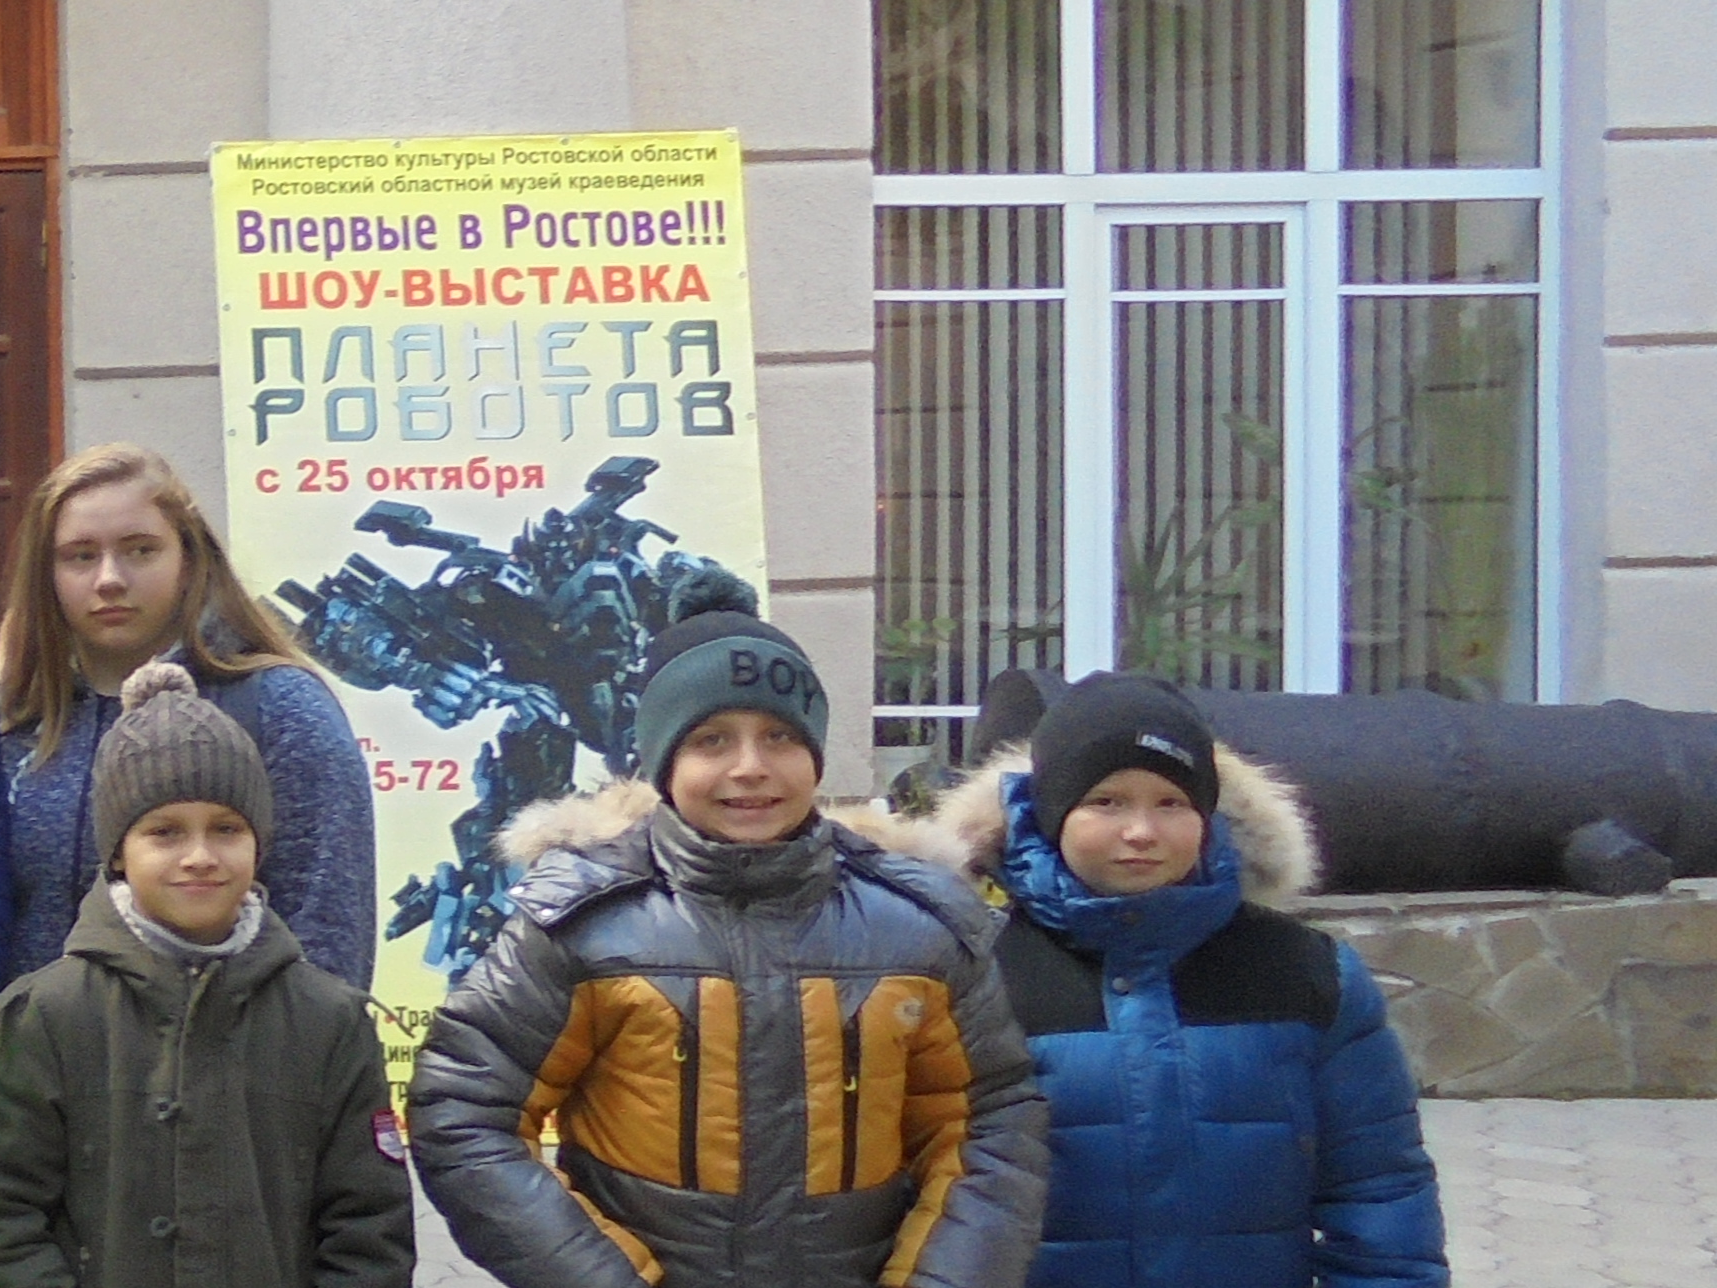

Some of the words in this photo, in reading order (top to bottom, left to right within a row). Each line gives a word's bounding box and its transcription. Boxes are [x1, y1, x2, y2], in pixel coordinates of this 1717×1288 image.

[237, 153, 387, 172] Министерство
[395, 152, 495, 171] культуры
[502, 145, 623, 165] Ростовской
[631, 144, 718, 163] области
[252, 176, 374, 196] Ростовский
[381, 174, 493, 194] областной
[500, 173, 561, 194] музей
[569, 173, 705, 192] краеведения
[237, 209, 438, 261] Впервые
[459, 213, 483, 250] в
[503, 200, 726, 249] Ростове!!!
[259, 264, 711, 310] ШОУ-ВЫСТАВКА
[250, 319, 721, 384] ПЛАНЕТА
[247, 381, 735, 446] РОБОТОВ
[256, 467, 281, 493] с
[296, 458, 350, 493] 25
[366, 456, 544, 498] октября
[373, 759, 461, 791] 5-72
